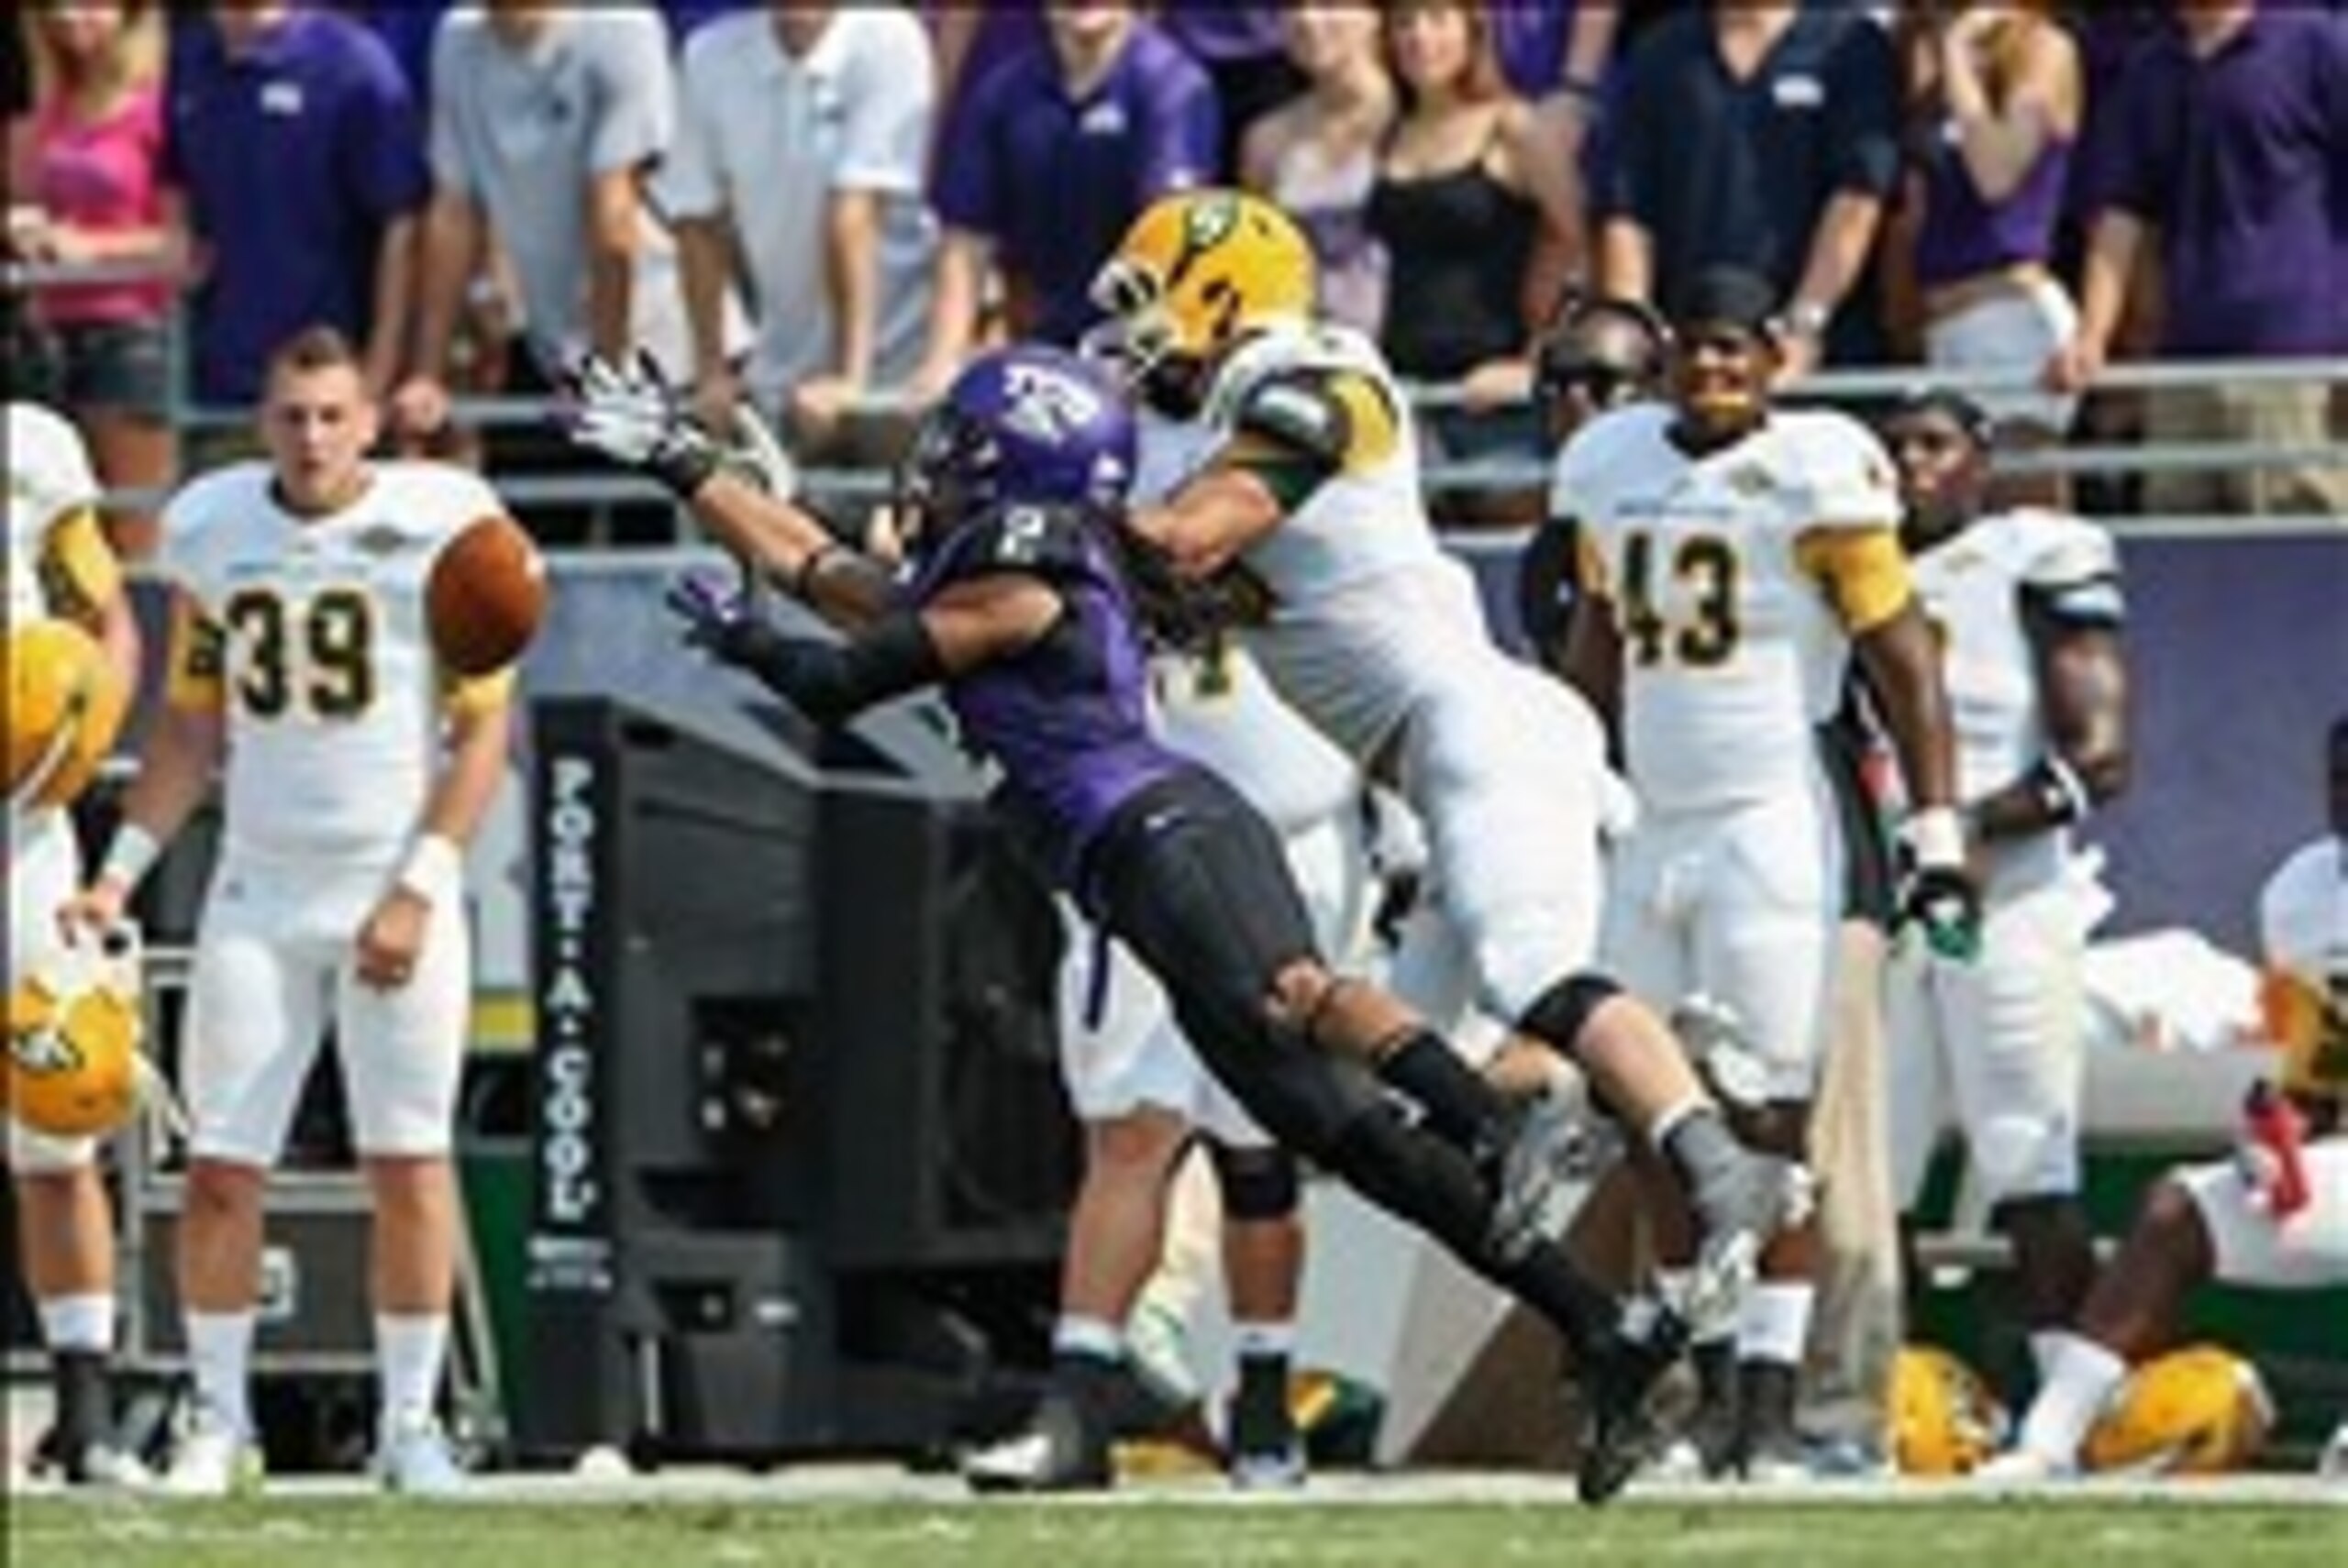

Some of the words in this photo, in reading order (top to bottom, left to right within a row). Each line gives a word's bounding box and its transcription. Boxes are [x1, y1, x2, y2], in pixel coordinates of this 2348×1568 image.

[998, 506, 1046, 563] 2
[1621, 528, 1742, 669] 43
[227, 588, 375, 719] 39
